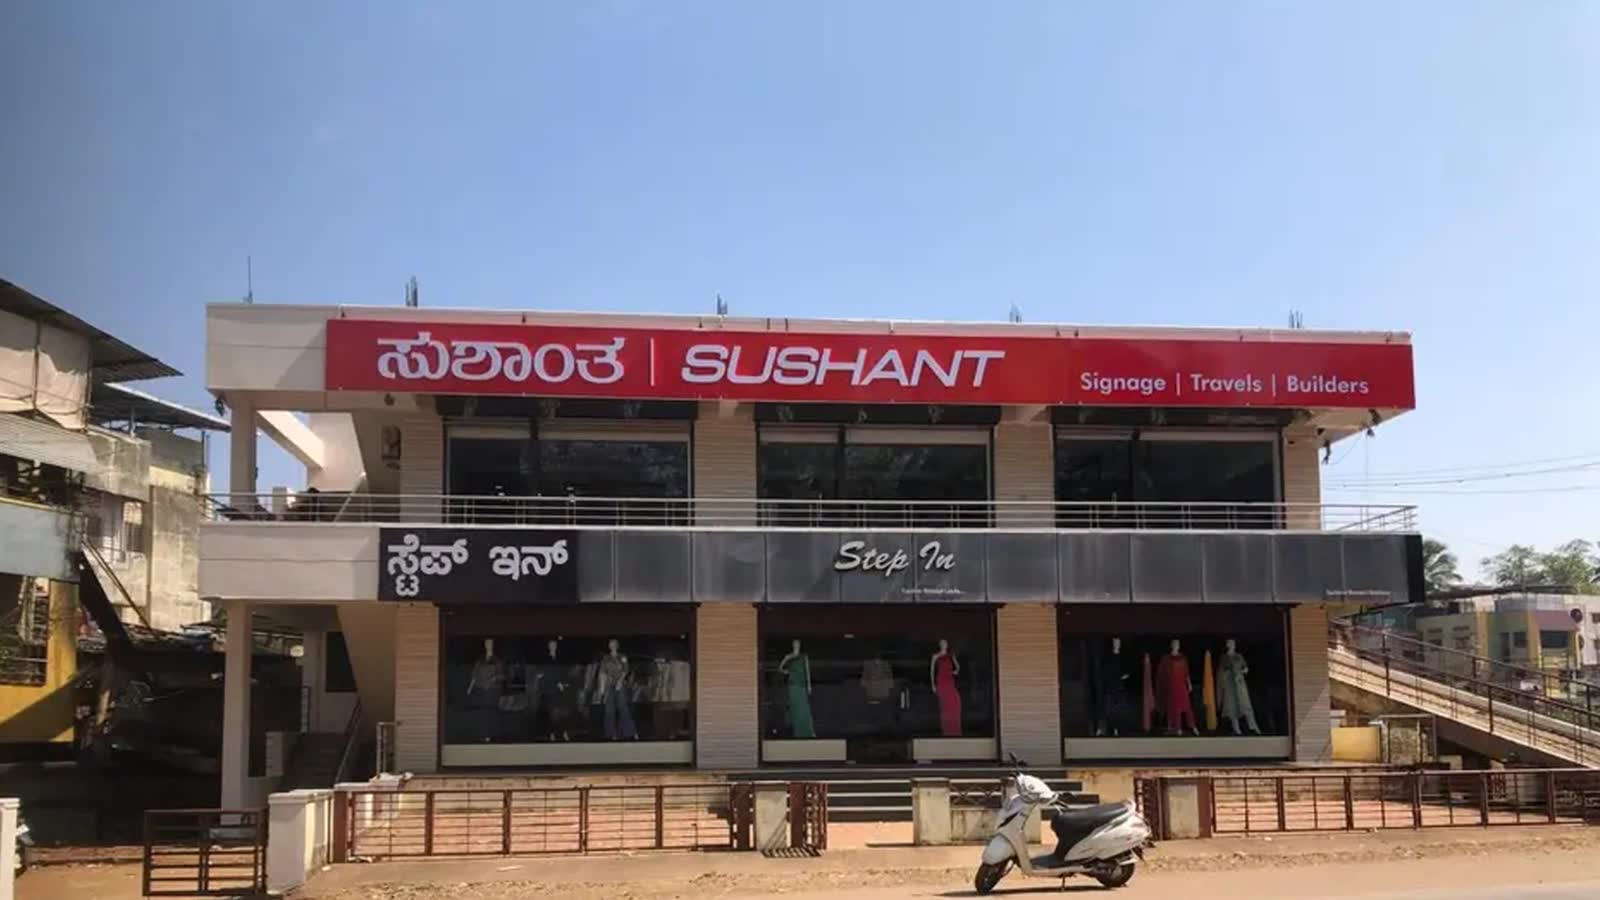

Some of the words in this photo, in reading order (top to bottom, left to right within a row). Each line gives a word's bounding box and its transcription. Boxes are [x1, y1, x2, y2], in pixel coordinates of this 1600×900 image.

[377, 331, 625, 384] ಸುಶಾಂತ
[681, 344, 1005, 387] SUSHANT
[1080, 371, 1167, 395] Signage
[1190, 373, 1263, 393] Travels
[1286, 375, 1370, 394] Builders
[387, 534, 469, 597] ಸ್ಟೆಪ್
[489, 539, 569, 581] ಇನ್
[834, 540, 909, 577] Step
[919, 540, 956, 571] In
